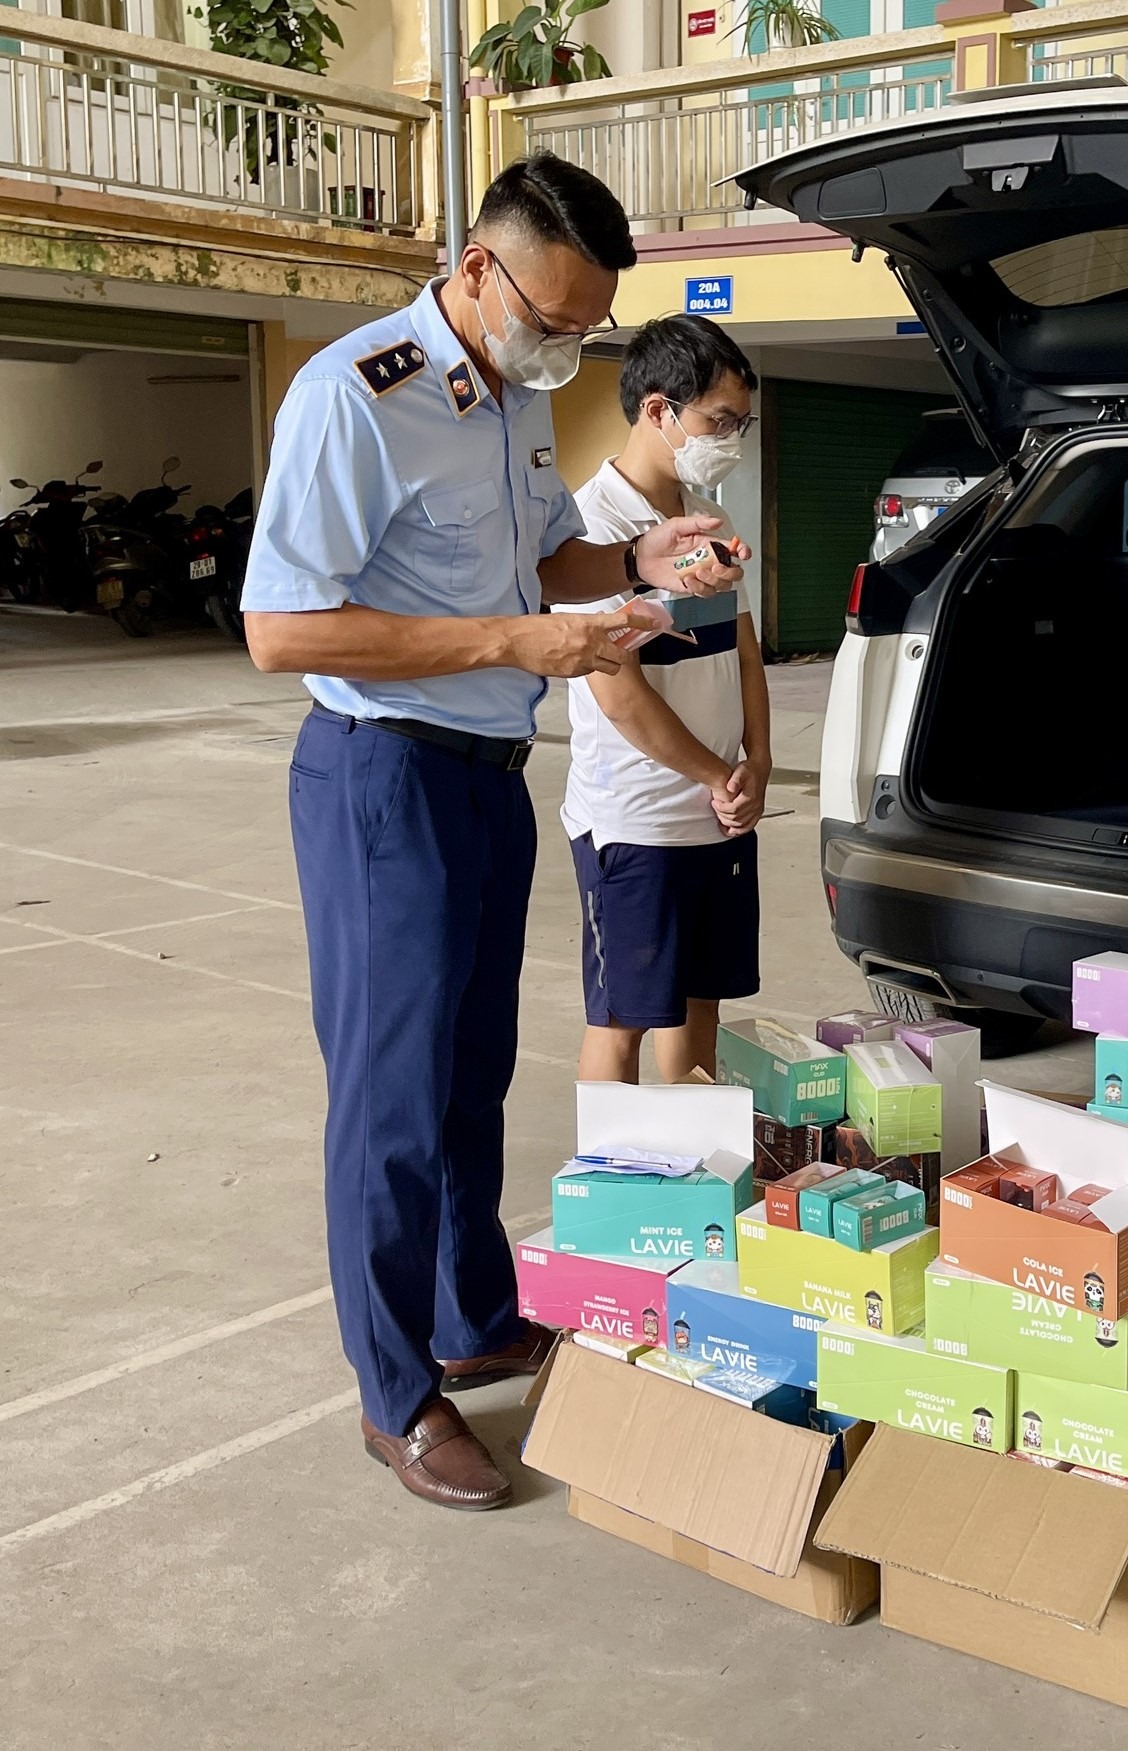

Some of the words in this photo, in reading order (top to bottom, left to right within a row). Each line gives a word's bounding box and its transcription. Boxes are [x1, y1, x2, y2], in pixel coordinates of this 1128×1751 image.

[698, 282, 721, 294] 20A
[690, 298, 728, 310] 004.04
[810, 1062, 829, 1072] MAX
[797, 1078, 836, 1101] 8000
[772, 1201, 790, 1211] LAVIE
[944, 1187, 970, 1209] 8000
[640, 1226, 664, 1236] MINT
[667, 1227, 683, 1236] ICE
[630, 1237, 694, 1256] LAVIE
[1023, 1257, 1047, 1273] COLA
[1049, 1263, 1064, 1278] ICE
[804, 1281, 833, 1295] BANANA
[834, 1289, 852, 1300] MILK
[1013, 1267, 1076, 1305] LAVIE
[801, 1292, 857, 1323] LAVIE
[580, 1311, 634, 1339] LAVIE
[792, 1314, 819, 1333] 8000
[1031, 1319, 1062, 1331] CREAM
[1020, 1327, 1074, 1344] CHOCOLATE
[822, 1337, 850, 1355] 8000
[701, 1344, 758, 1372] LAVIE
[905, 1388, 956, 1407] CHOCOLATE
[916, 1401, 945, 1414] CREAM
[897, 1408, 963, 1440] LAVIE
[1062, 1418, 1115, 1438] CHOCOLATE
[1073, 1431, 1104, 1444] CREAM
[1054, 1438, 1124, 1472] LAVIE
